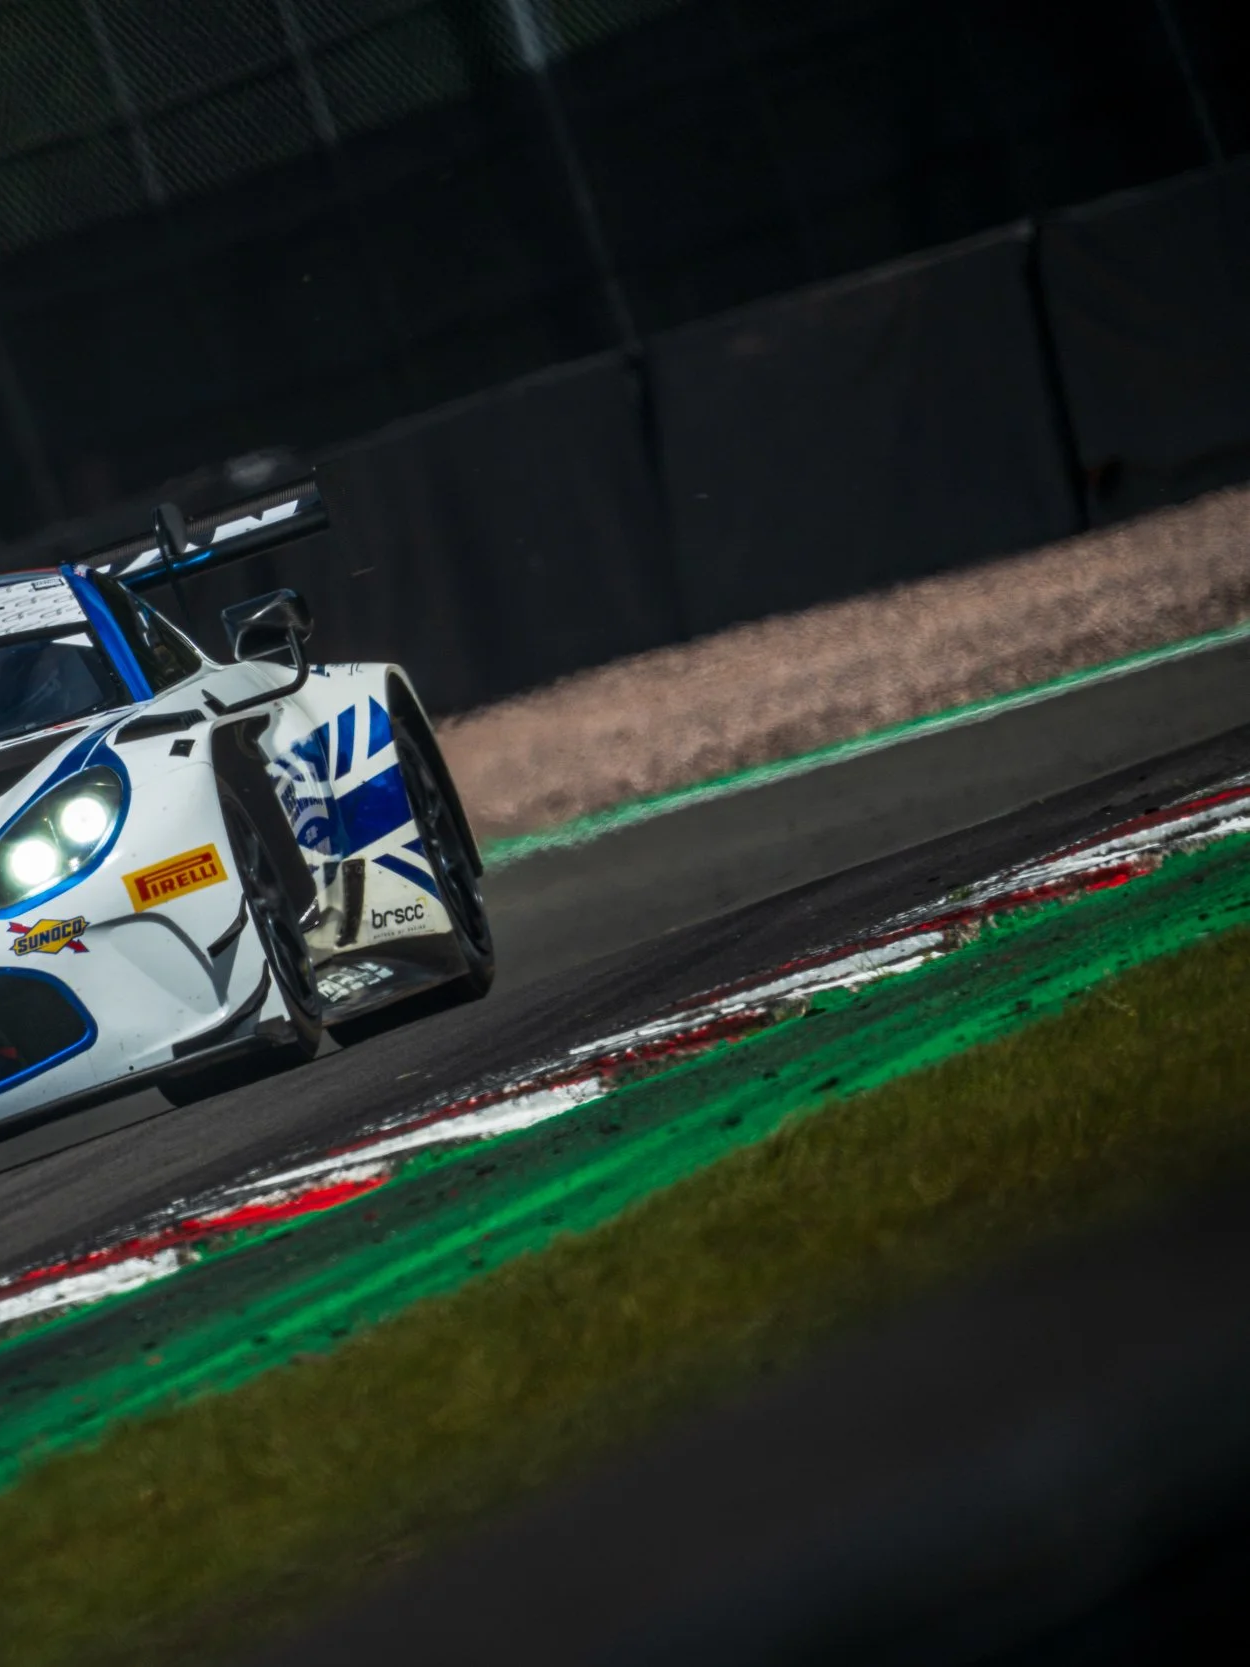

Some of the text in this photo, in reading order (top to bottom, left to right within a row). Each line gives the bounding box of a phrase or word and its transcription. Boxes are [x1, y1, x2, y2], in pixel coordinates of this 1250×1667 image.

[134, 852, 218, 901] PIRELLI
[371, 903, 424, 929] brscc
[16, 919, 83, 953] SUNOCO
